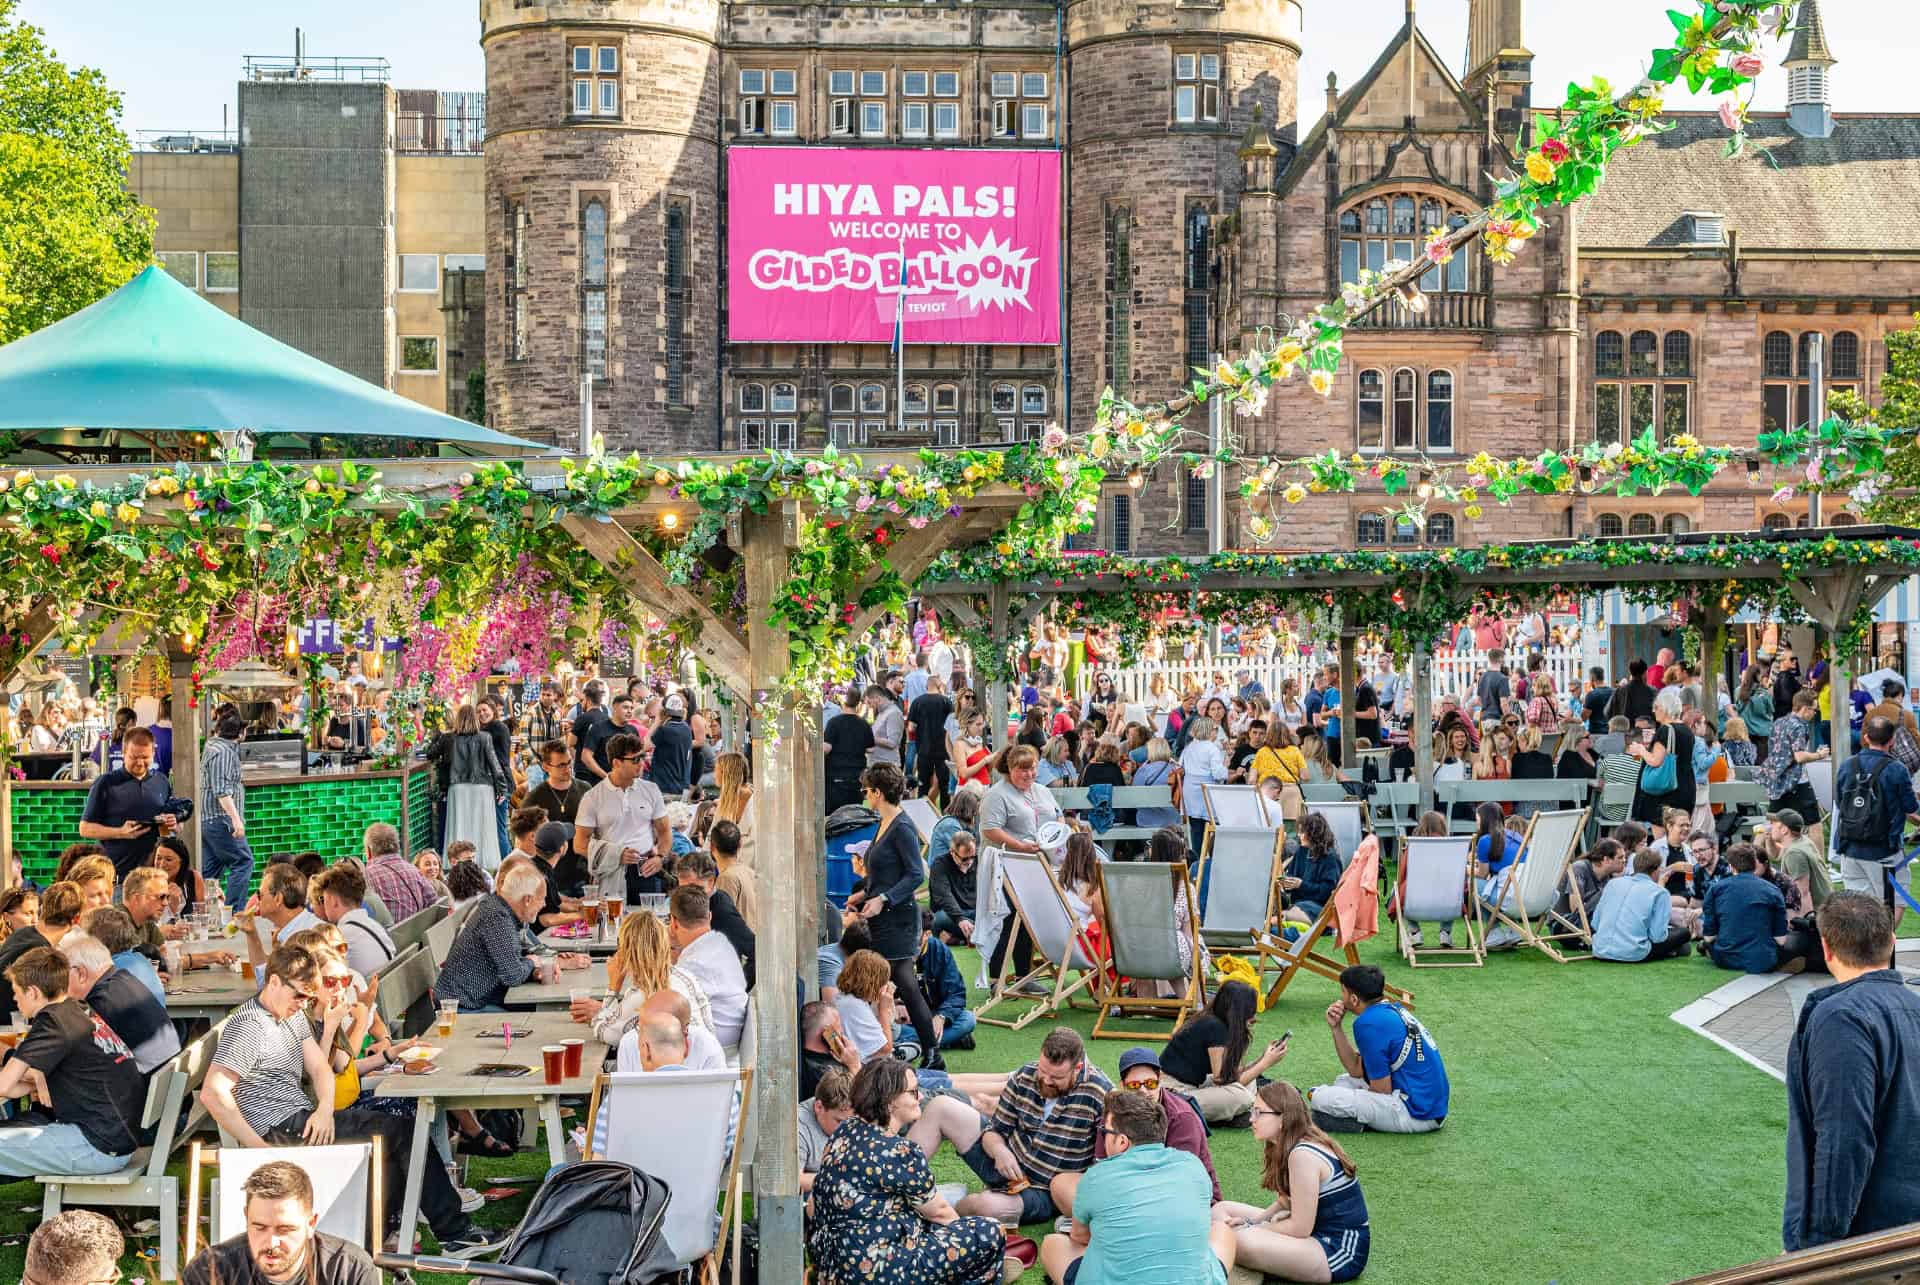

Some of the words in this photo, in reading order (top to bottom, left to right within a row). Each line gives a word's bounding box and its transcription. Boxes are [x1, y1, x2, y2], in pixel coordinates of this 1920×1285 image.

[774, 183, 881, 215] HIYA
[893, 185, 1016, 218] PALS!
[829, 221, 930, 239] WELCOME
[934, 223, 961, 239] TO
[753, 250, 872, 288] GILDED
[878, 254, 1024, 290] BALLOON
[907, 301, 946, 313] TEVIOT
